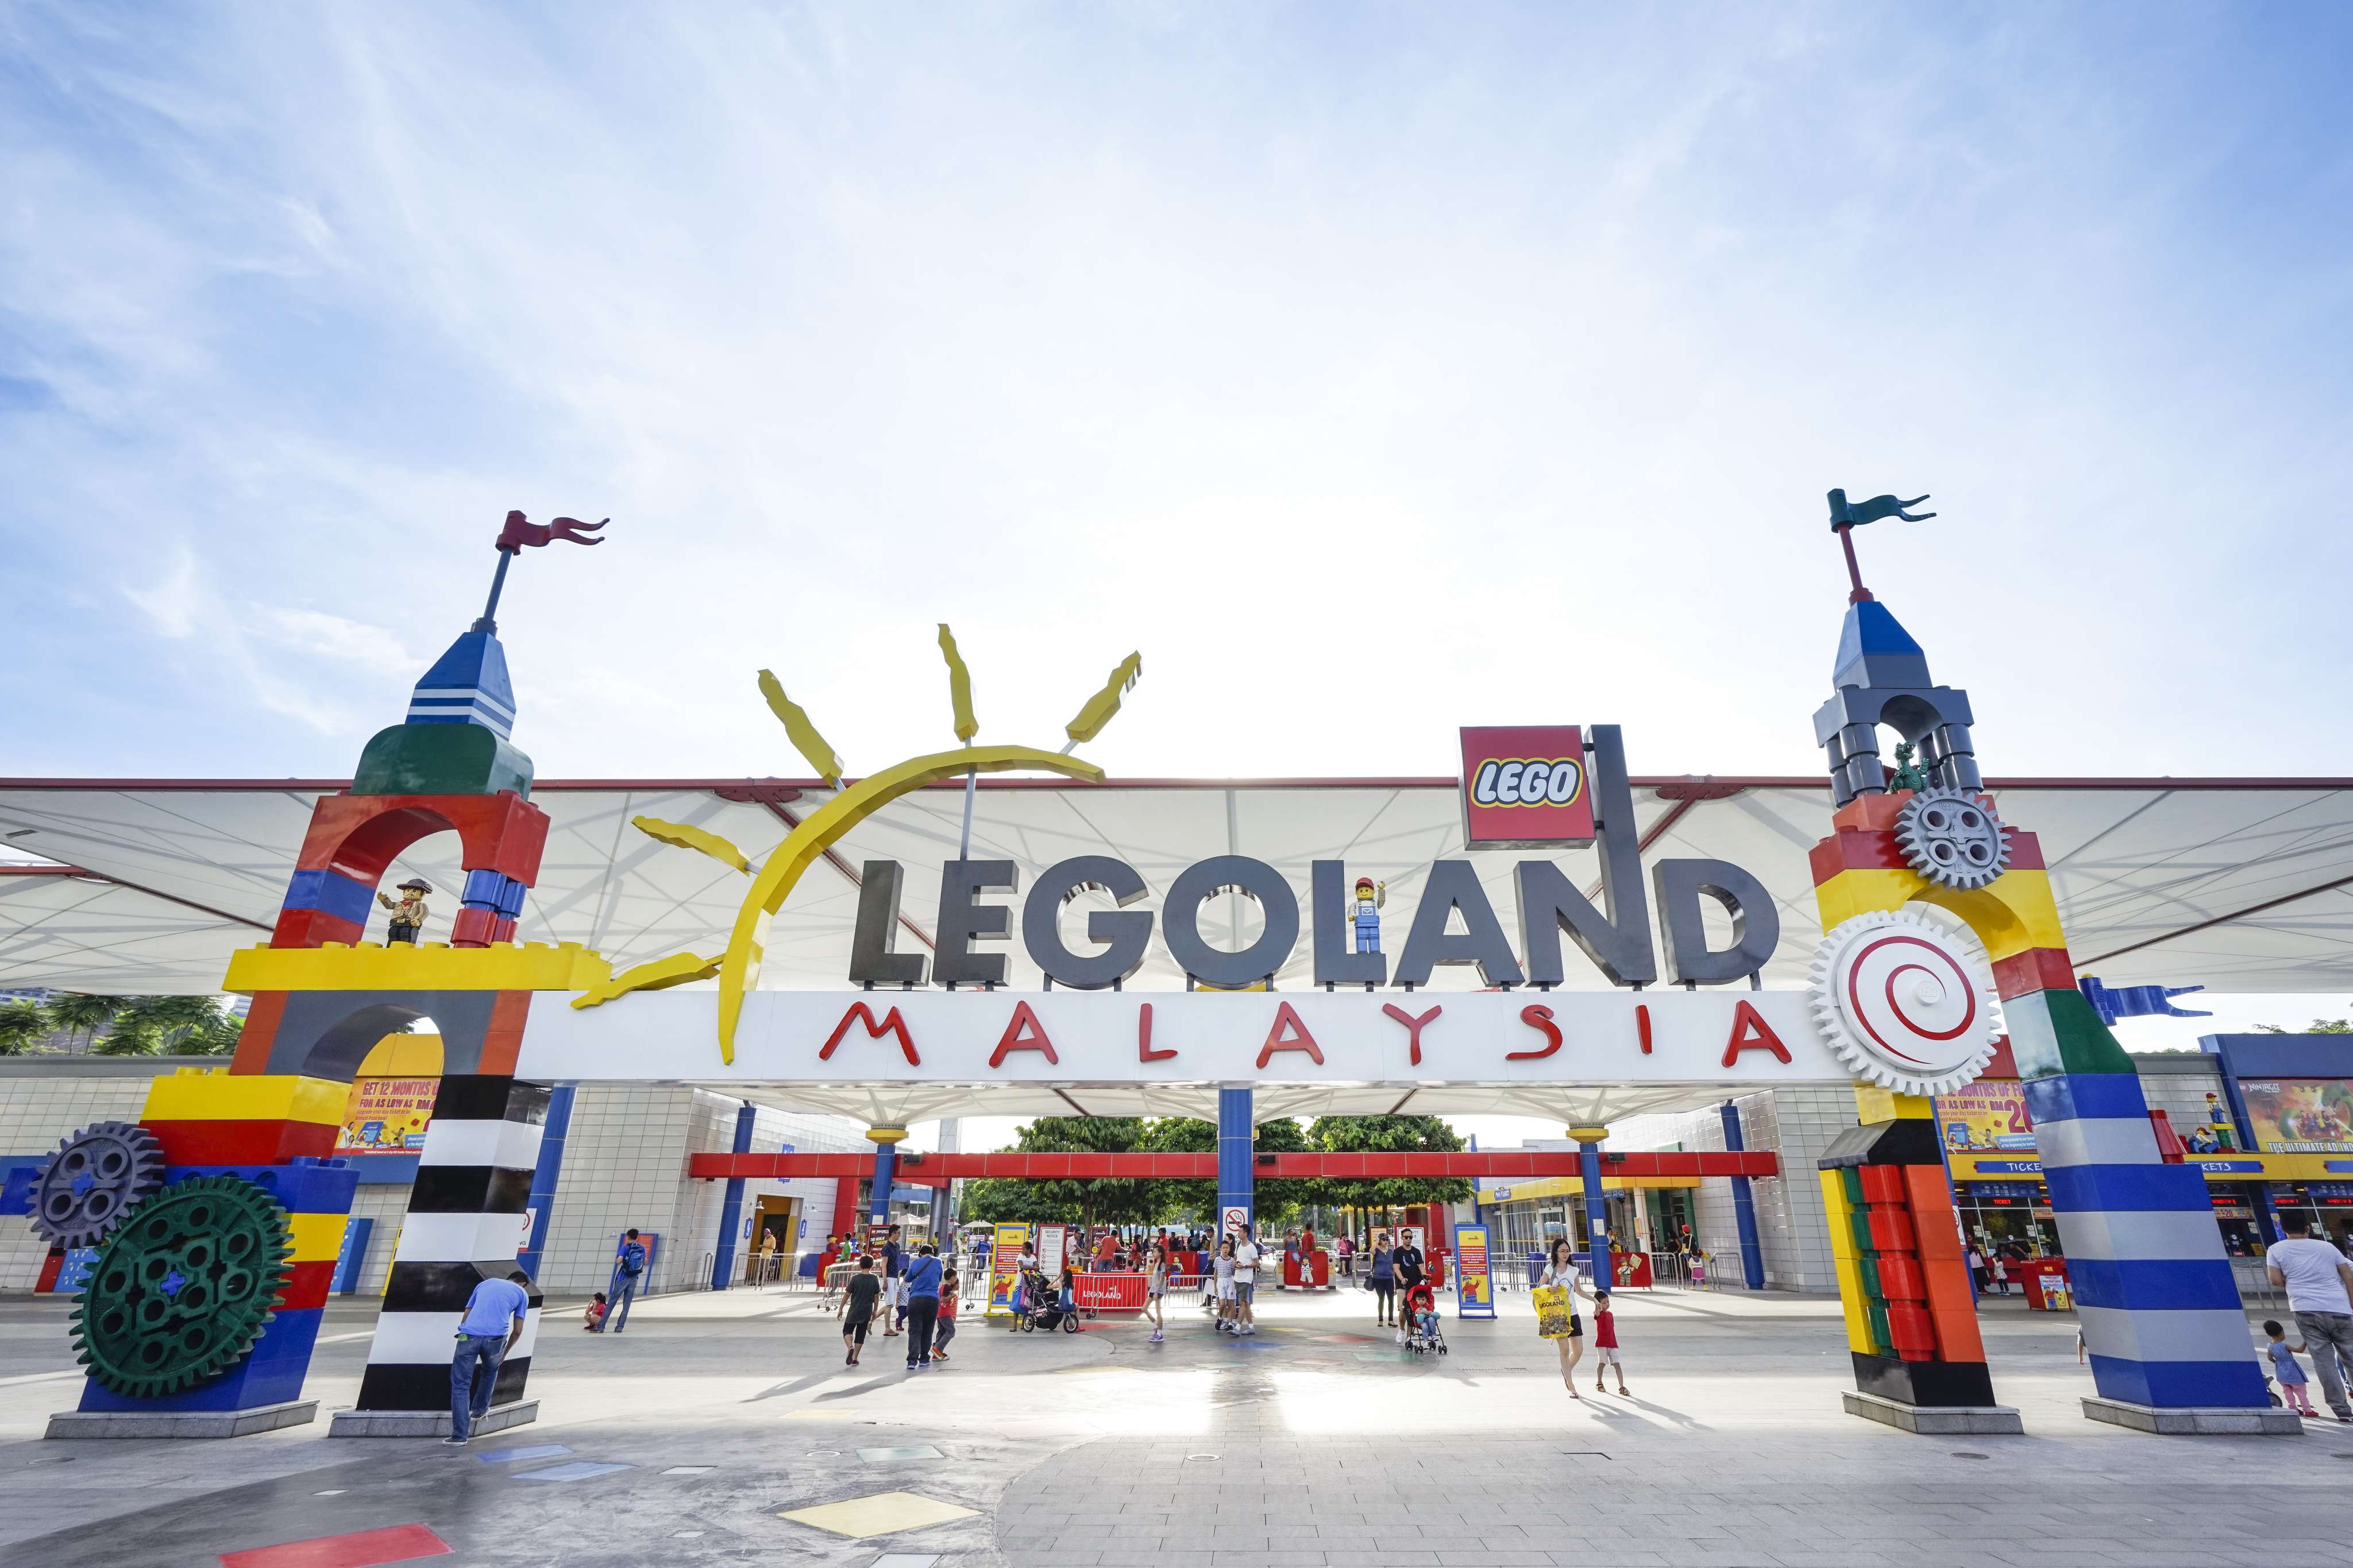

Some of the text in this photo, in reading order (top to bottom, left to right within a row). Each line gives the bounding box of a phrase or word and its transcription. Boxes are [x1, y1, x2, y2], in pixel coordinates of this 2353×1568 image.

[1475, 761, 1580, 805] LEGO
[849, 724, 1779, 990] LEGOLAND
[819, 1000, 1792, 1068] MALAYSIA
[362, 1082, 379, 1095] GET
[380, 1082, 390, 1095] 12
[391, 1082, 431, 1095] MONTHS
[1958, 1082, 1997, 1097] MONTHS
[1997, 1082, 2010, 1097] OF
[2247, 1083, 2282, 1092] NINJAGO
[359, 1099, 373, 1107] FOR
[375, 1099, 385, 1107] AS
[387, 1099, 403, 1107] LOW
[403, 1099, 414, 1107] AS
[1949, 1100, 1958, 1109] AS
[1960, 1100, 1975, 1109] LOW
[1977, 1100, 1986, 1109] AS
[2267, 1142, 2284, 1153] THE
[2284, 1142, 2324, 1152] ULTIMATE
[2327, 1142, 2338, 1152] 4D
[2007, 1163, 2042, 1171] TICKE
[2202, 1163, 2231, 1171] KETS
[1083, 1285, 1121, 1299] LEGOLAND
